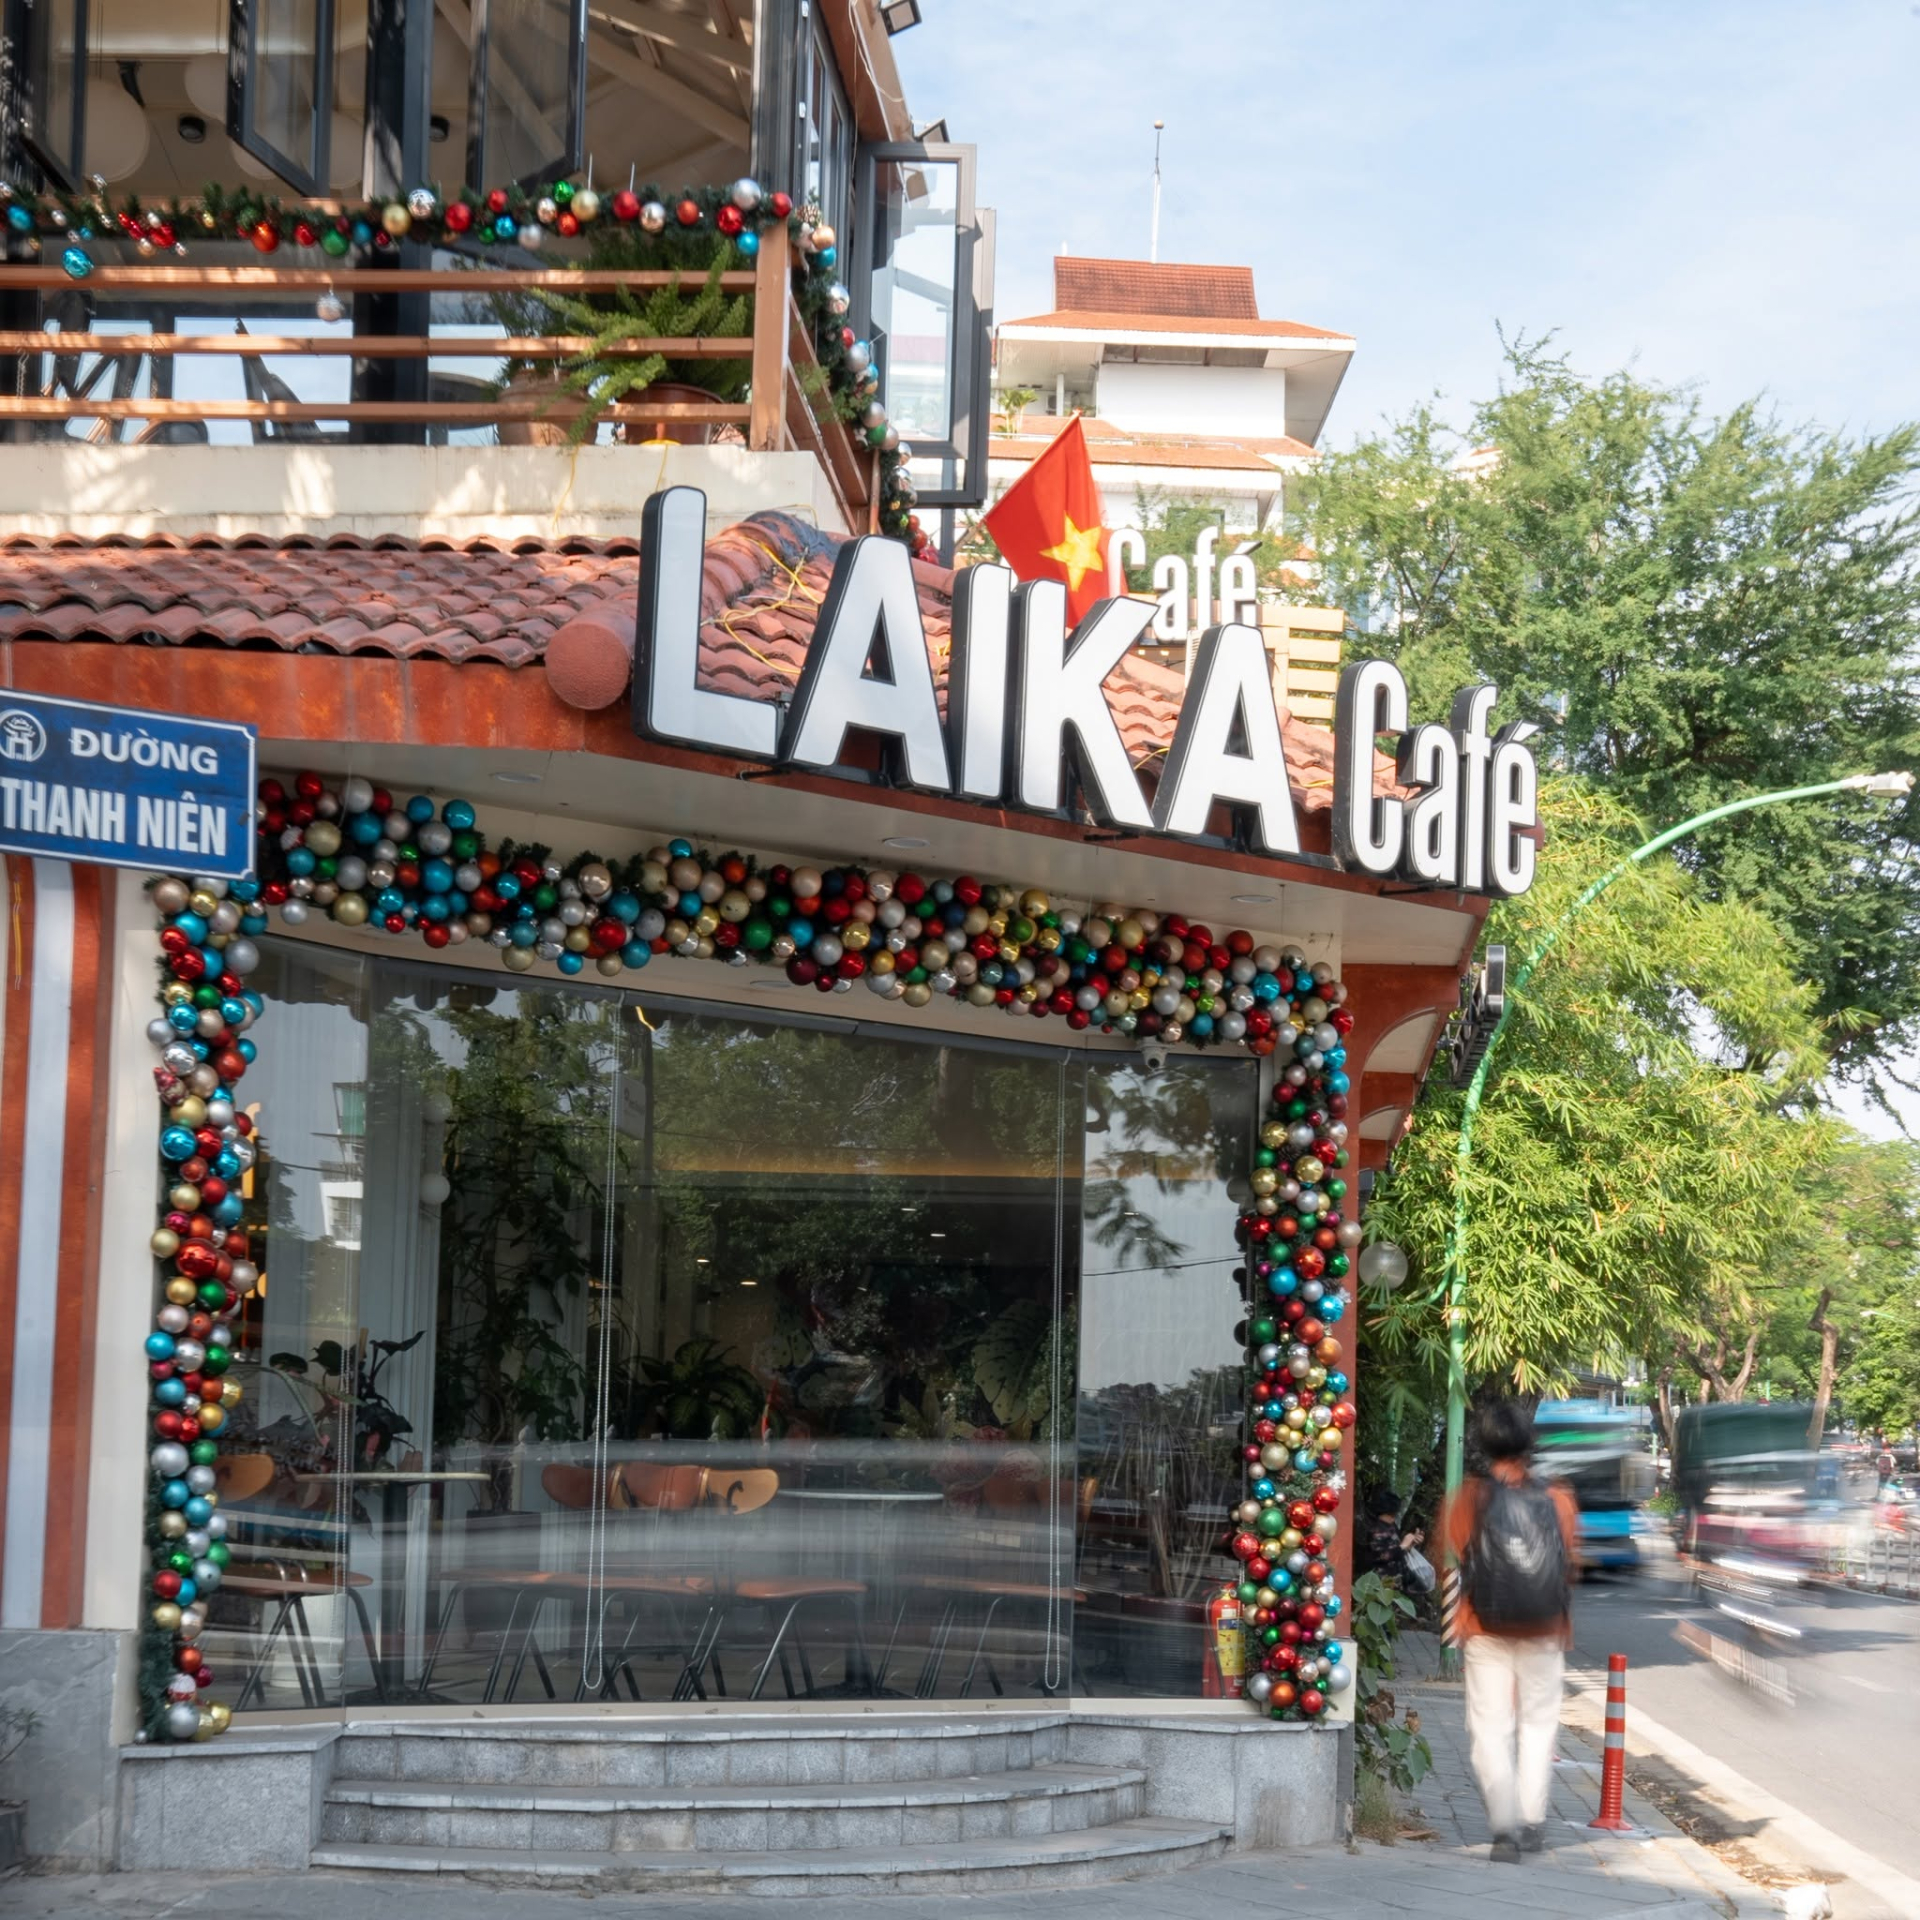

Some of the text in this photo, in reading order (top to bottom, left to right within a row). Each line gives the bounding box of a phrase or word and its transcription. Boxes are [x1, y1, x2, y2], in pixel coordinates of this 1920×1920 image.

[634, 485, 1544, 895] LAIKA Café
[68, 727, 219, 775] ĐƯỜNG
[0, 776, 227, 856] THANH NIÊN
